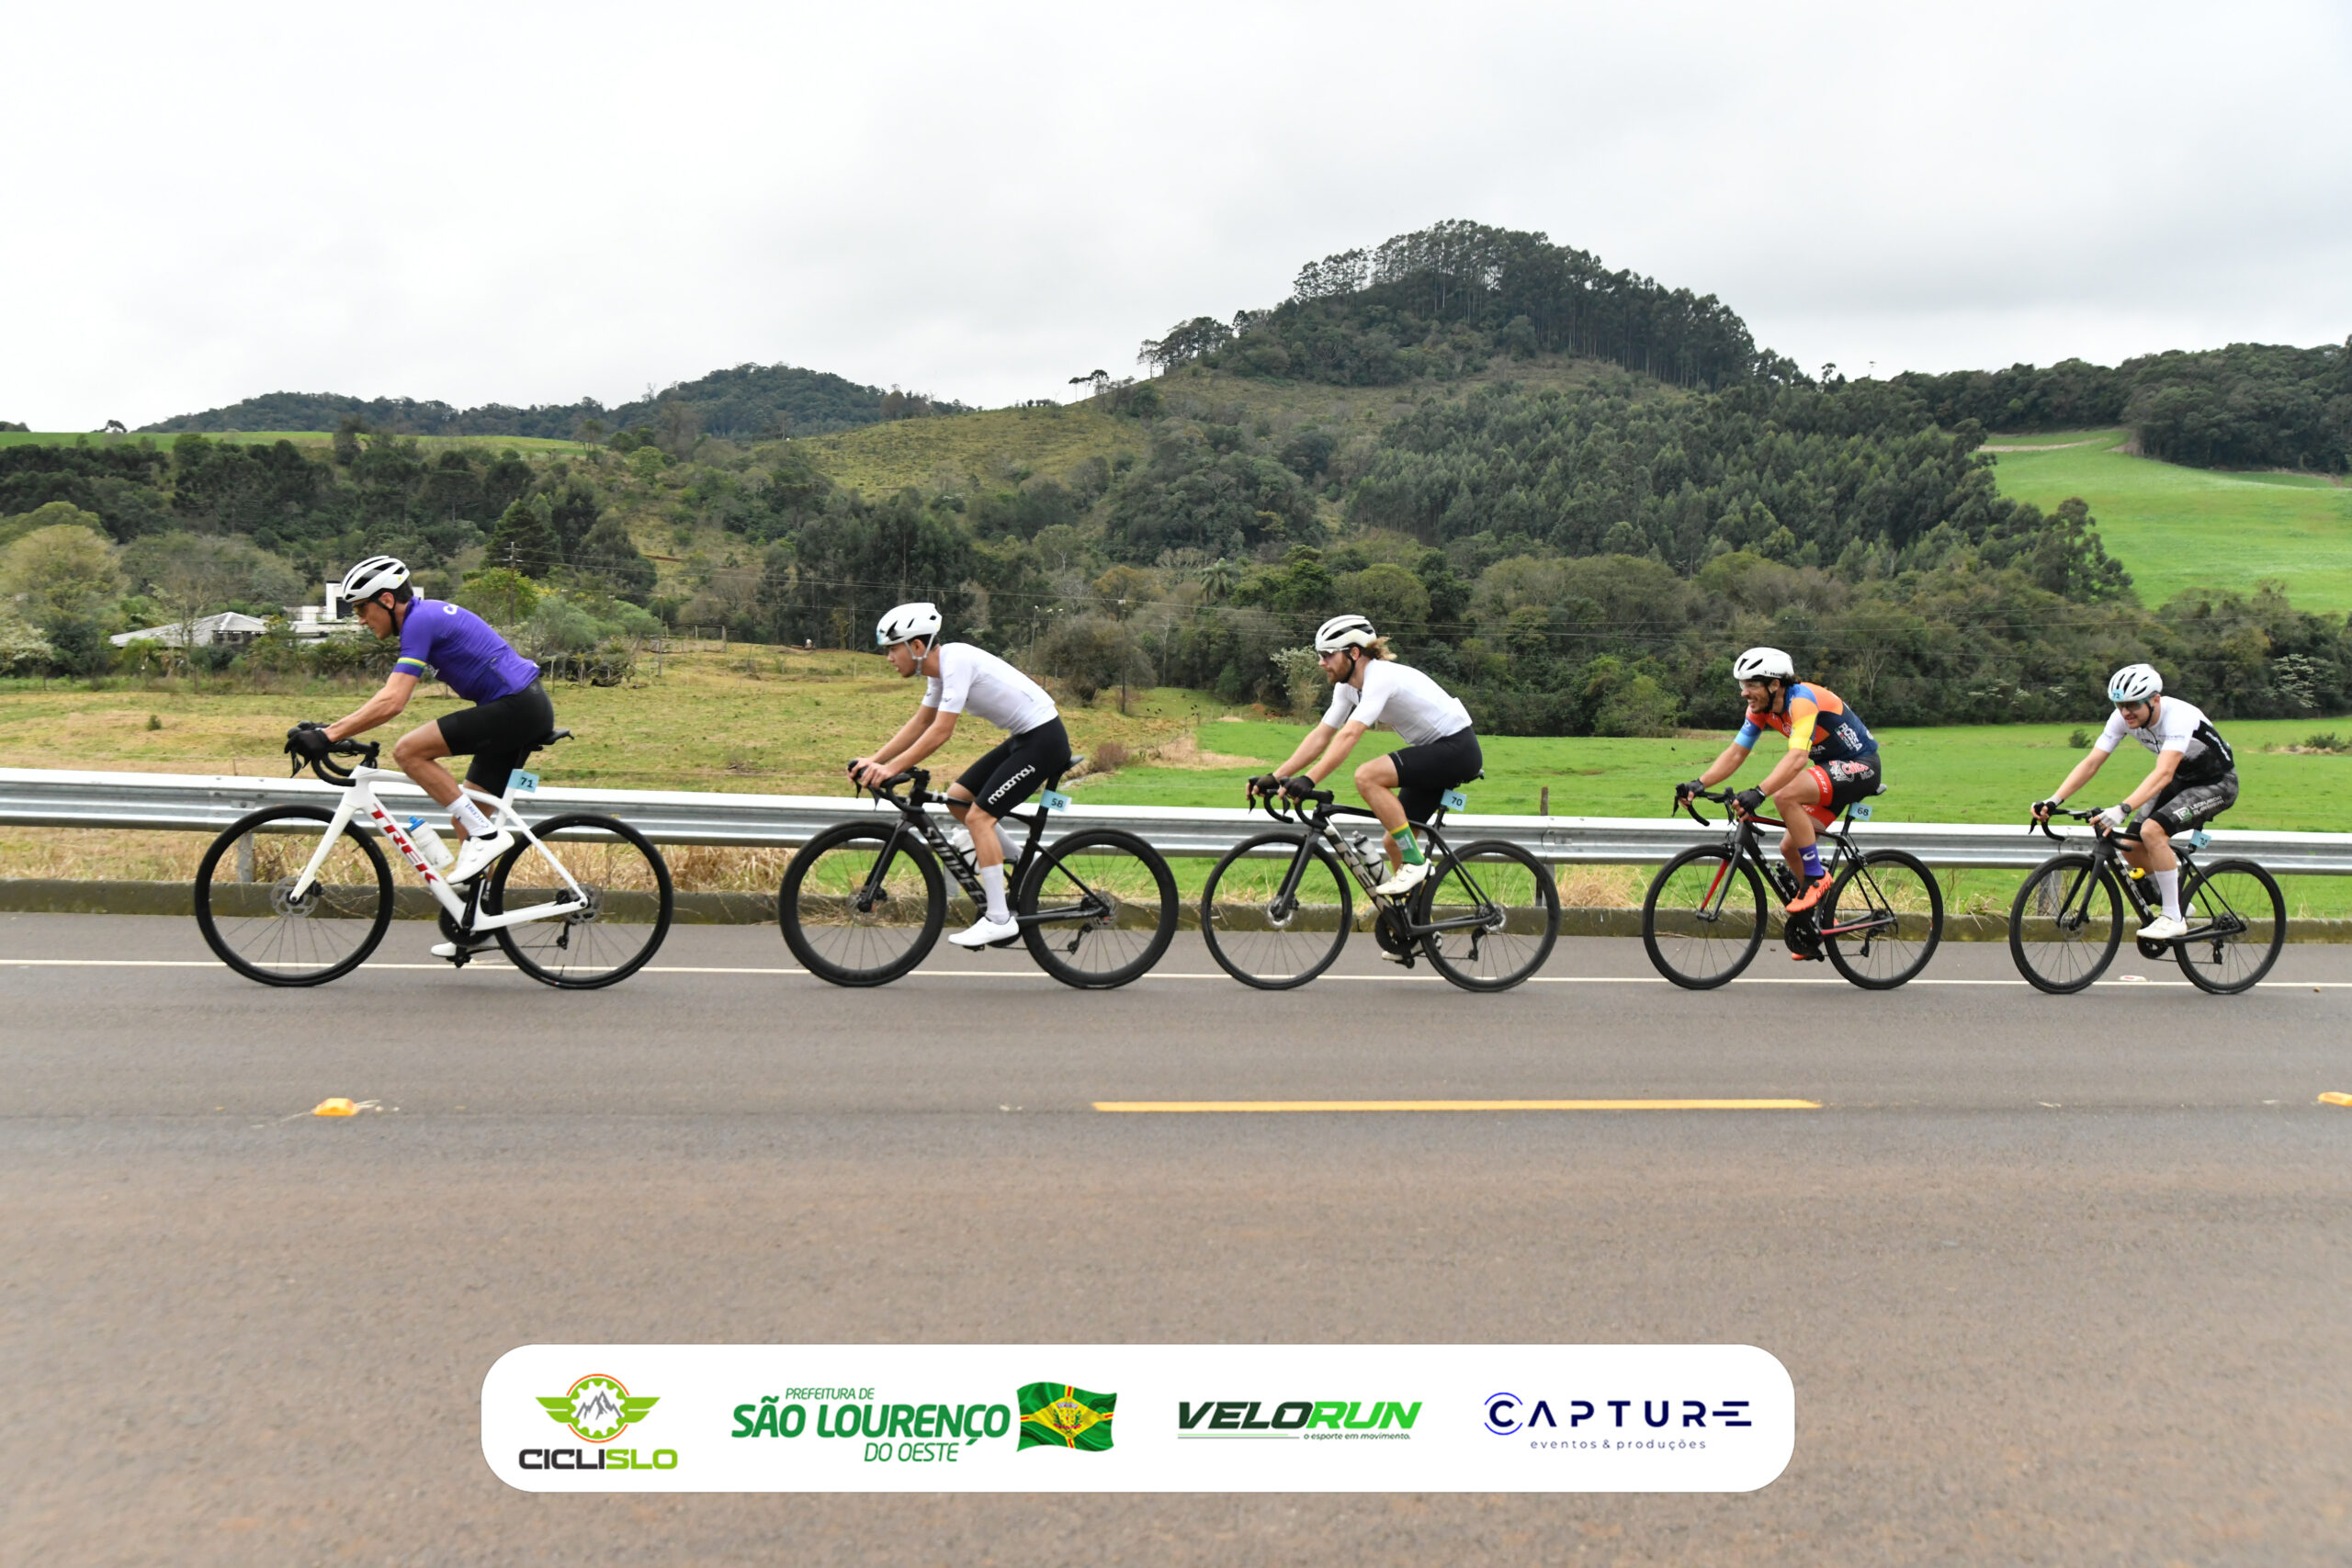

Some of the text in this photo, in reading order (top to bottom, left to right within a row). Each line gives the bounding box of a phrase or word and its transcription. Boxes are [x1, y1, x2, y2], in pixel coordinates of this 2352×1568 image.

[1838, 722, 1863, 751] ROSSA
[520, 776, 534, 788] 71
[1051, 797, 1064, 808] 58
[1451, 796, 1463, 807] 70
[1857, 807, 1869, 817] 68
[370, 803, 438, 884] TREK
[924, 826, 989, 909] SUNPEE
[1323, 817, 1391, 912] TREK
